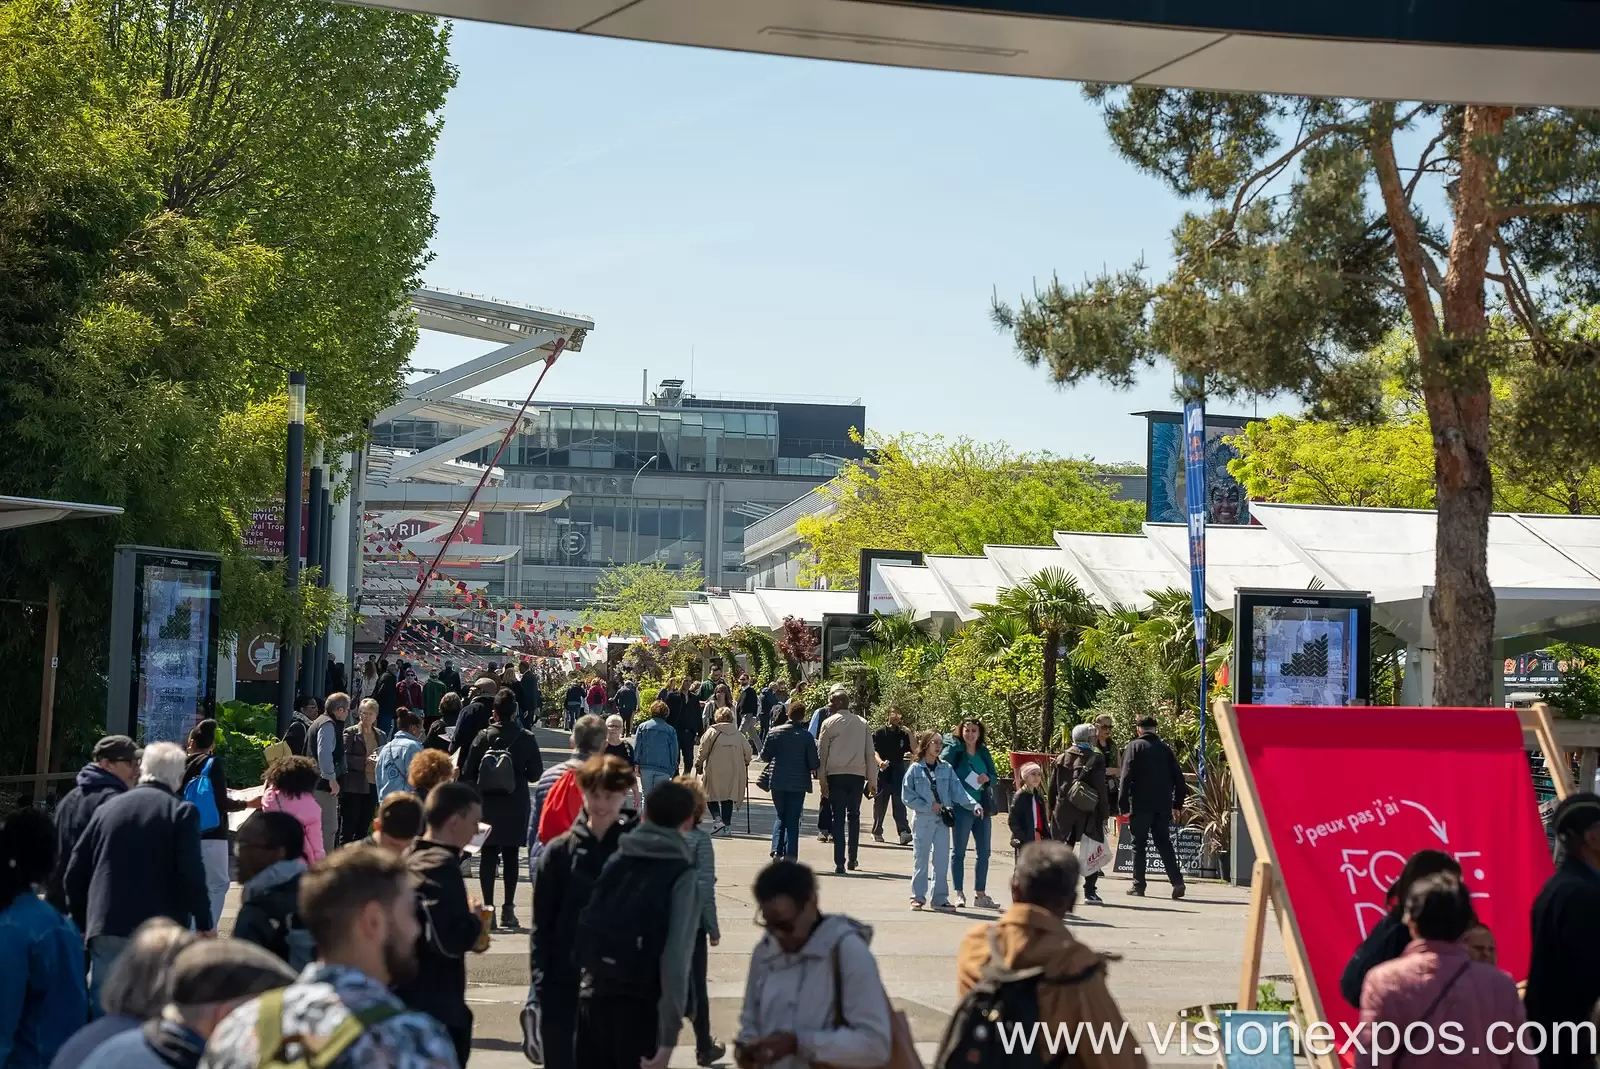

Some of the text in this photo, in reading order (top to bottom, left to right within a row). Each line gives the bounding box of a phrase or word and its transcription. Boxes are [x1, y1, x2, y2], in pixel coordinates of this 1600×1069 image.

[1293, 796, 1400, 847] J'peux pas j'ai
